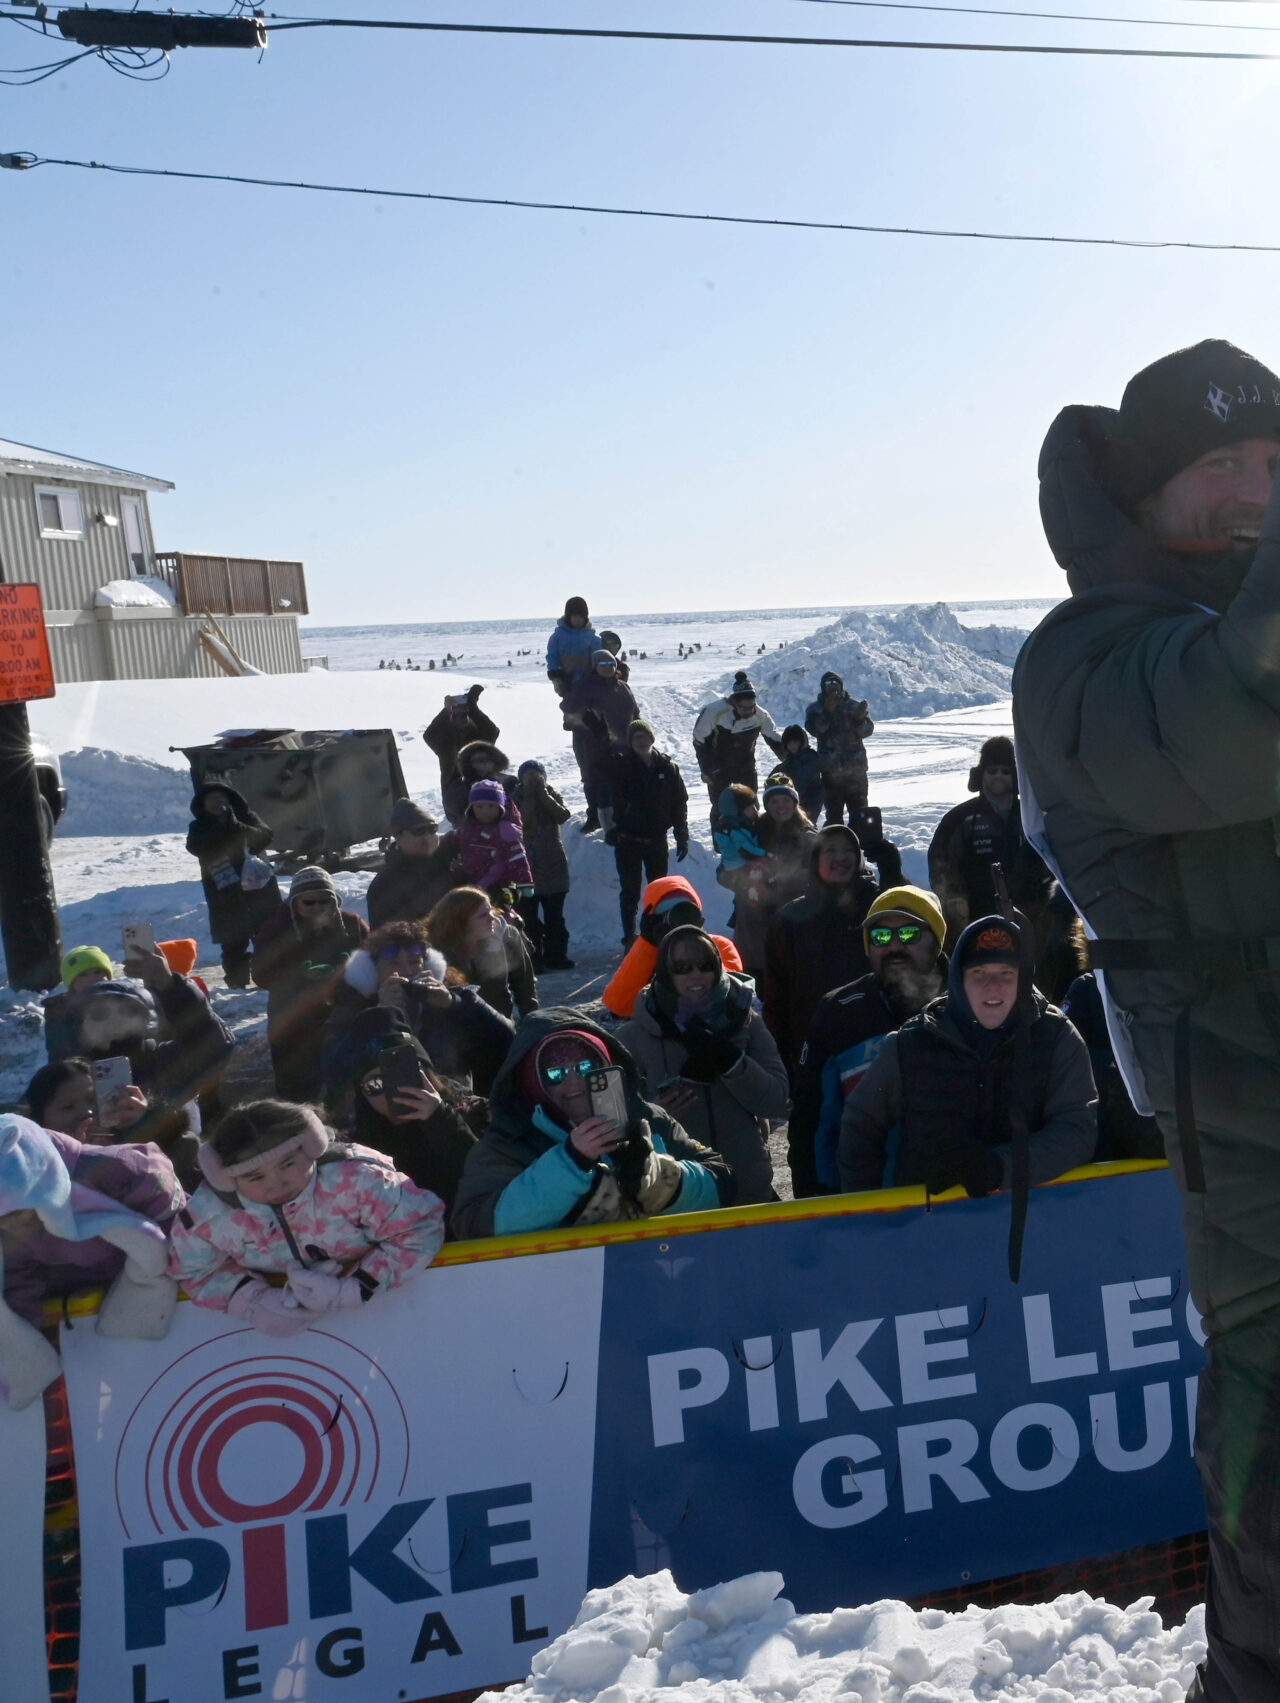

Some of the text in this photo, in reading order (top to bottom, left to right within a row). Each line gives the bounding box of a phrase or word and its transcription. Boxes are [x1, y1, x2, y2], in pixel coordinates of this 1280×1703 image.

[0, 607, 40, 625] RKING
[0, 628, 37, 641] :00 AM
[10, 644, 24, 656] TO
[26, 657, 41, 670] AM
[647, 1305, 978, 1448] PIKE
[122, 1482, 539, 1651] PIKE
[132, 1595, 549, 1703] LEGAL
